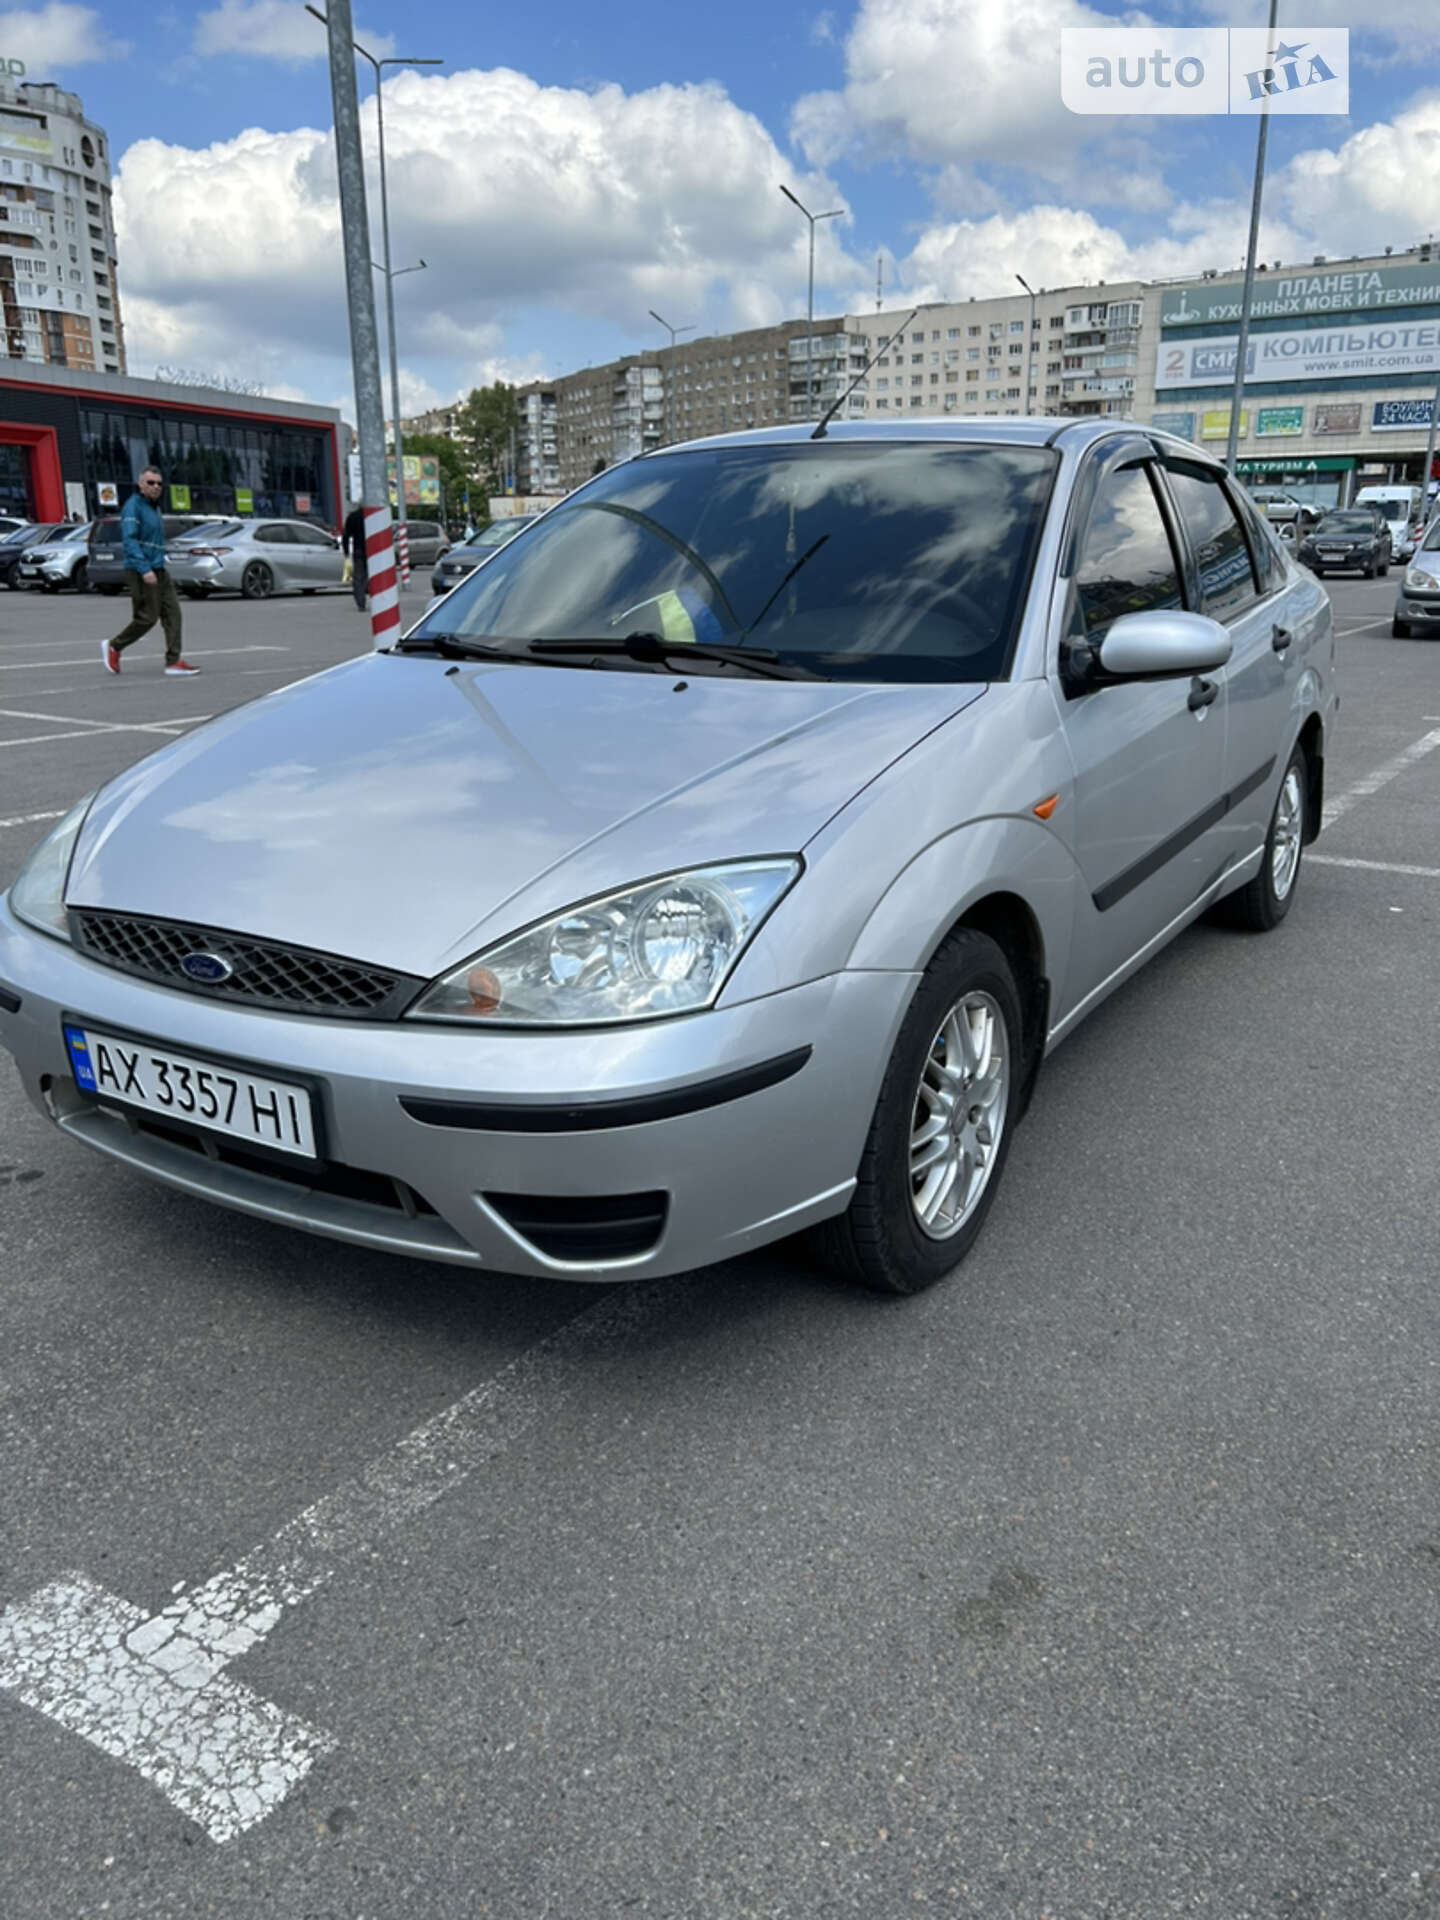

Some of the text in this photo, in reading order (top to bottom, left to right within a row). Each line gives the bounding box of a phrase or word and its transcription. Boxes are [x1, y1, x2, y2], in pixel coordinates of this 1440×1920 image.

[1277, 271, 1383, 298] ПЛАНЕТА
[1207, 297, 1300, 320] КУХННЫХ
[1304, 292, 1354, 312] МОЕК
[1357, 292, 1370, 306] И
[1263, 326, 1440, 358] КОМПЬЮТЕ
[1303, 353, 1434, 371] www.smit.com.ua
[1383, 401, 1434, 414] БОУЛИН
[96, 1042, 147, 1100] AX
[151, 1057, 238, 1125] 3357
